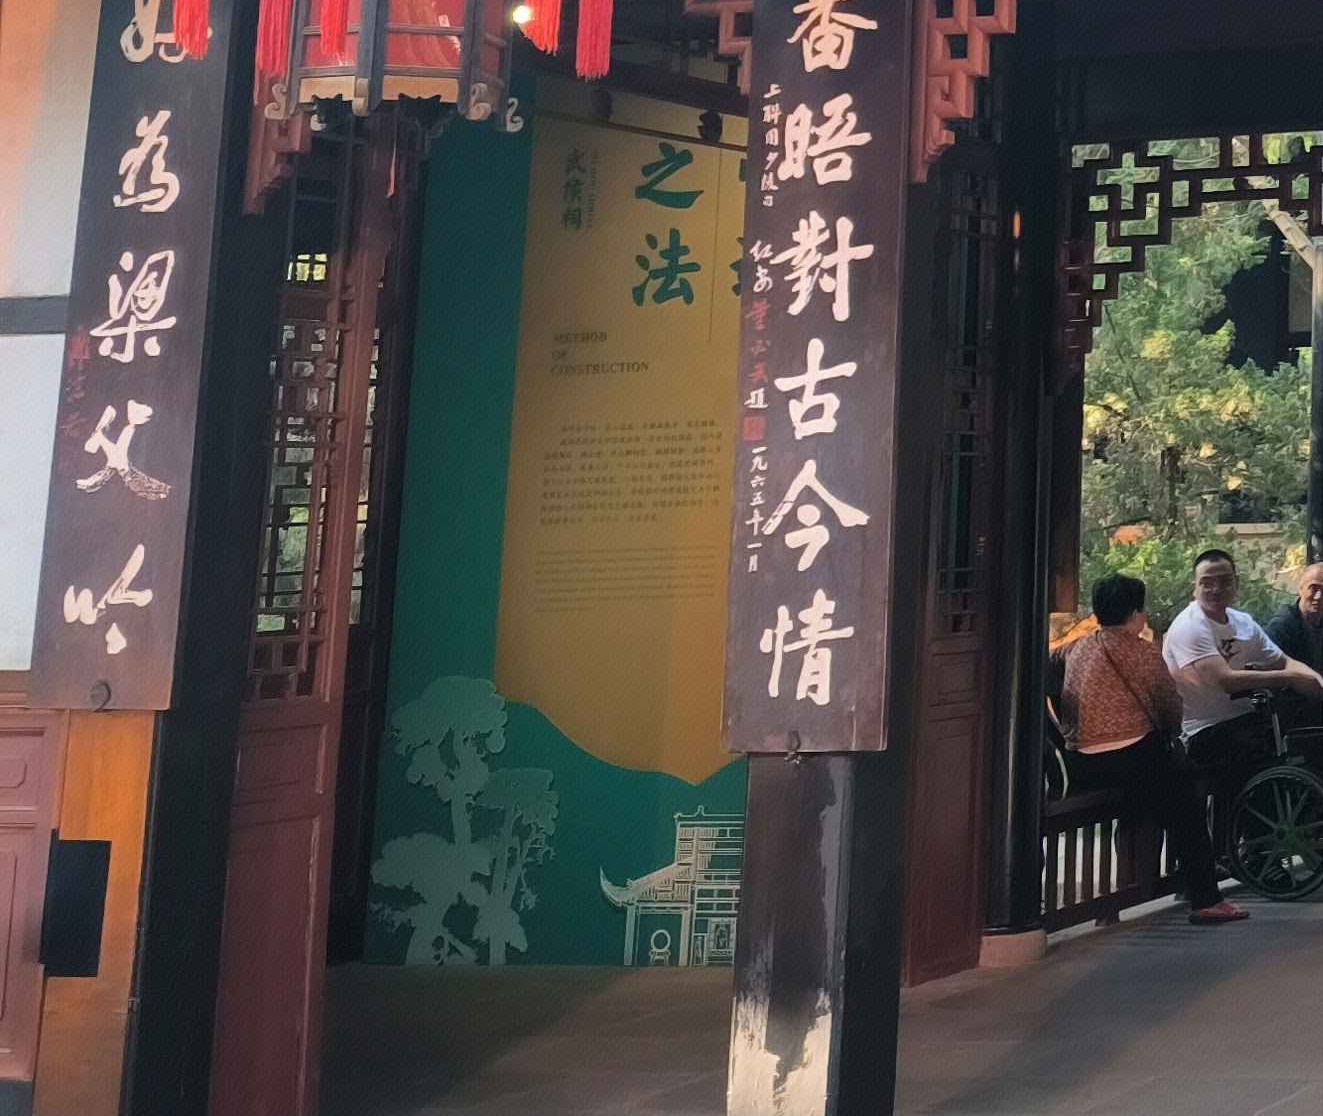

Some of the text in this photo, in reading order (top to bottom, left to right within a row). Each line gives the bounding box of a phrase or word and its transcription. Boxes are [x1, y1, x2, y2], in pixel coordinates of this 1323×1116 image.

[561, 148, 586, 230] 武侯祠
[633, 141, 703, 307] 之法
[553, 332, 607, 344] METHOD
[552, 350, 568, 360] OF
[550, 361, 649, 375] CONSTRUCTION
